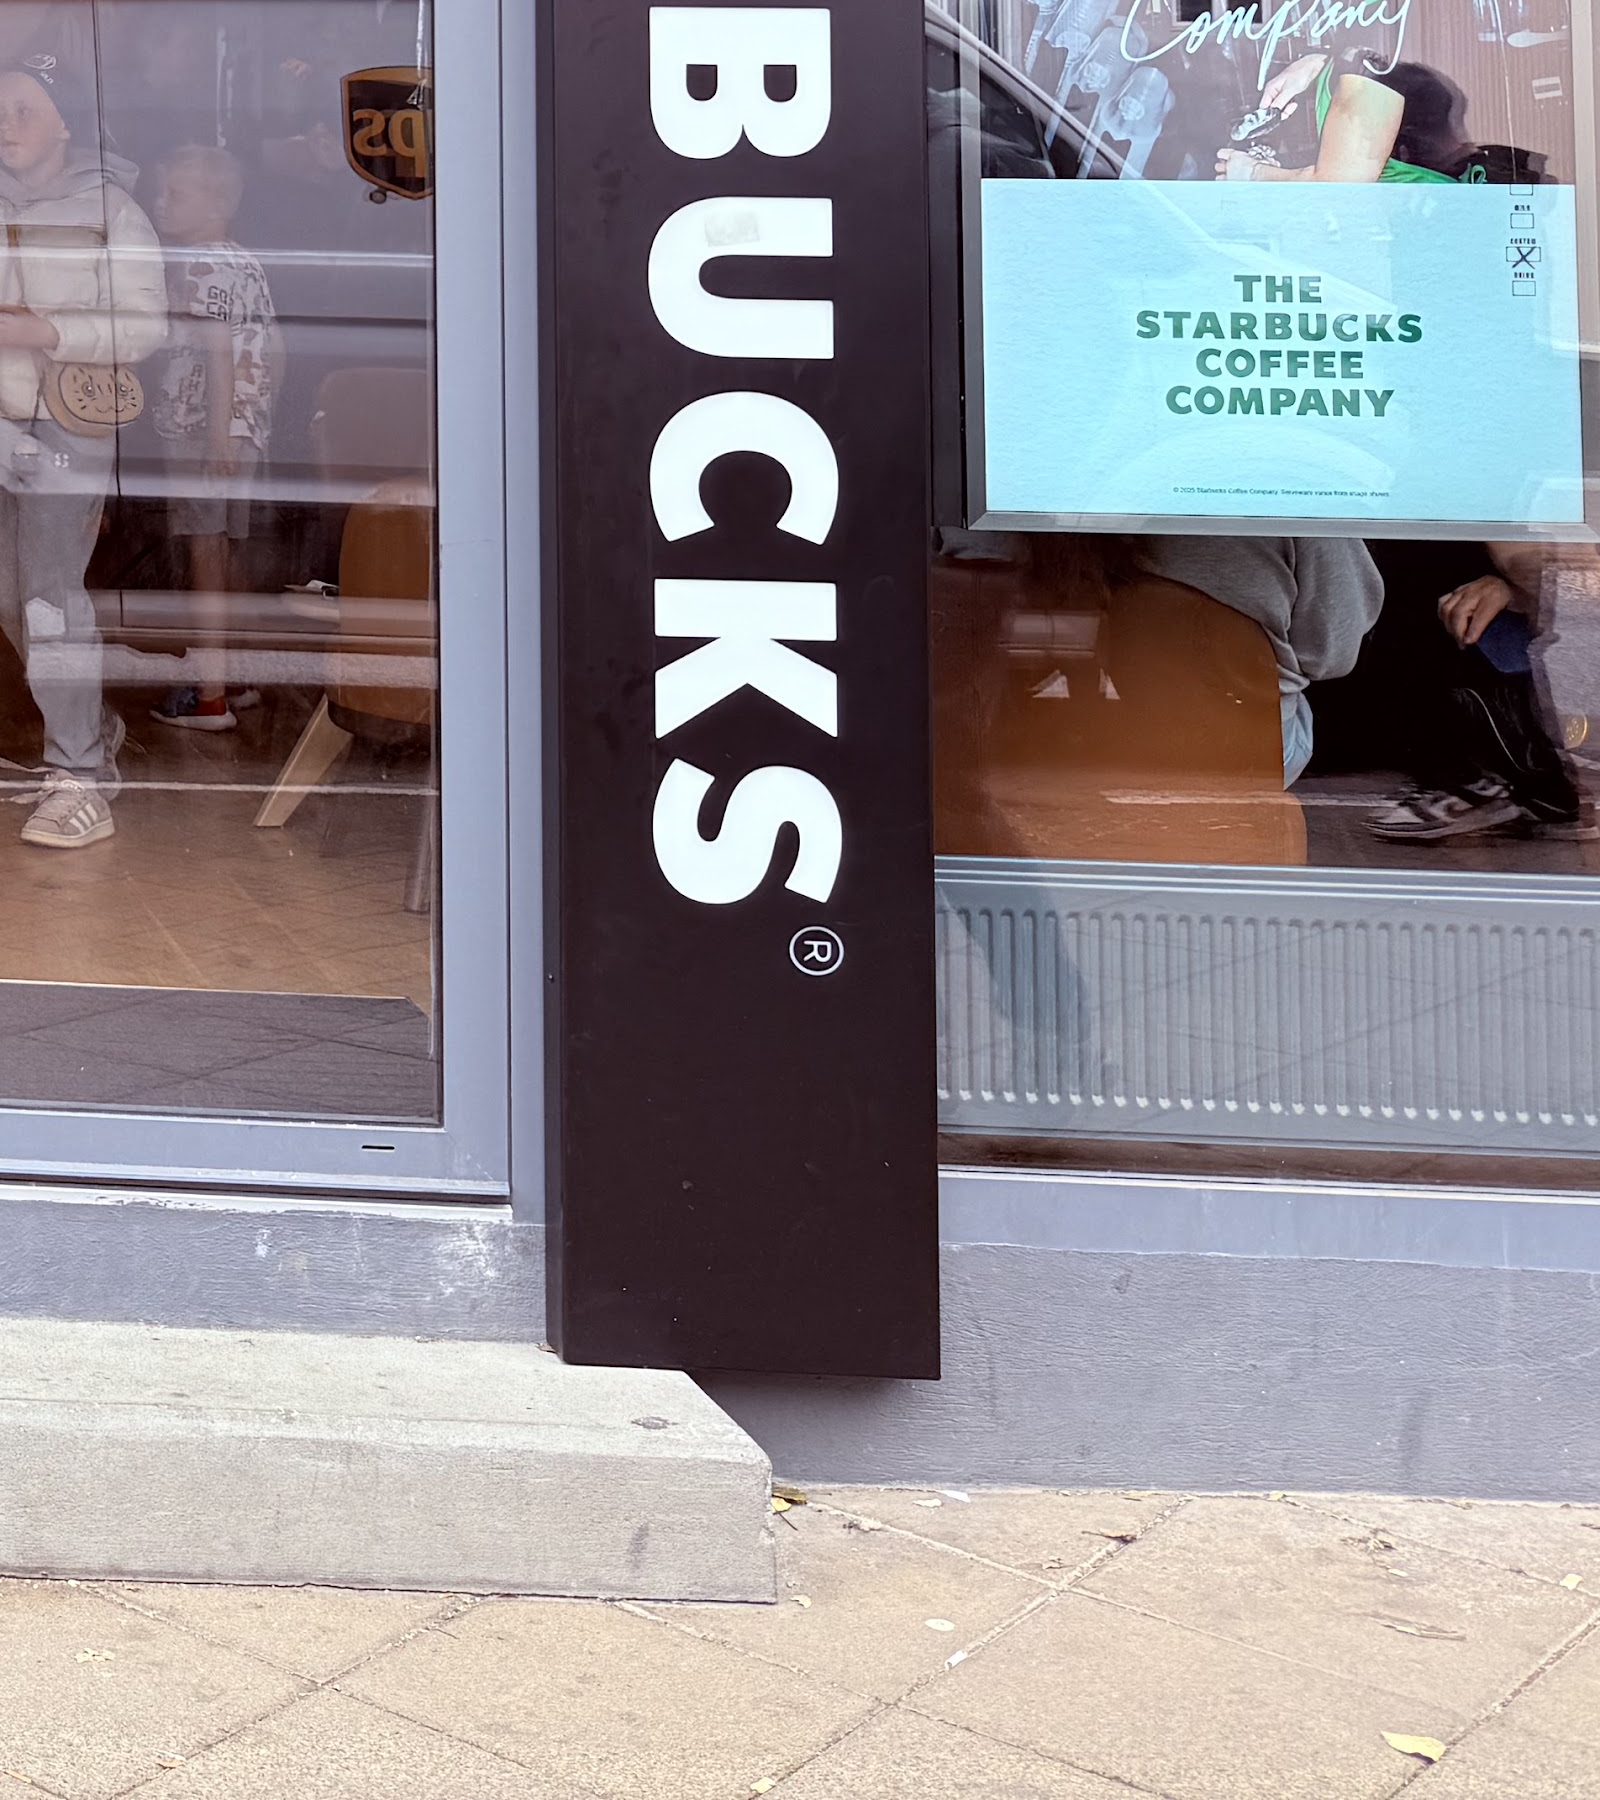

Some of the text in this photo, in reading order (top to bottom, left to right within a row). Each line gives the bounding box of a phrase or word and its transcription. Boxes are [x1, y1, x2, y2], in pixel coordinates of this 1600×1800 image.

[1234, 274, 1322, 303] THE
[1136, 310, 1423, 343] STARBUCKS
[1196, 348, 1364, 378] COFFEE
[1166, 385, 1395, 417] COMPANY
